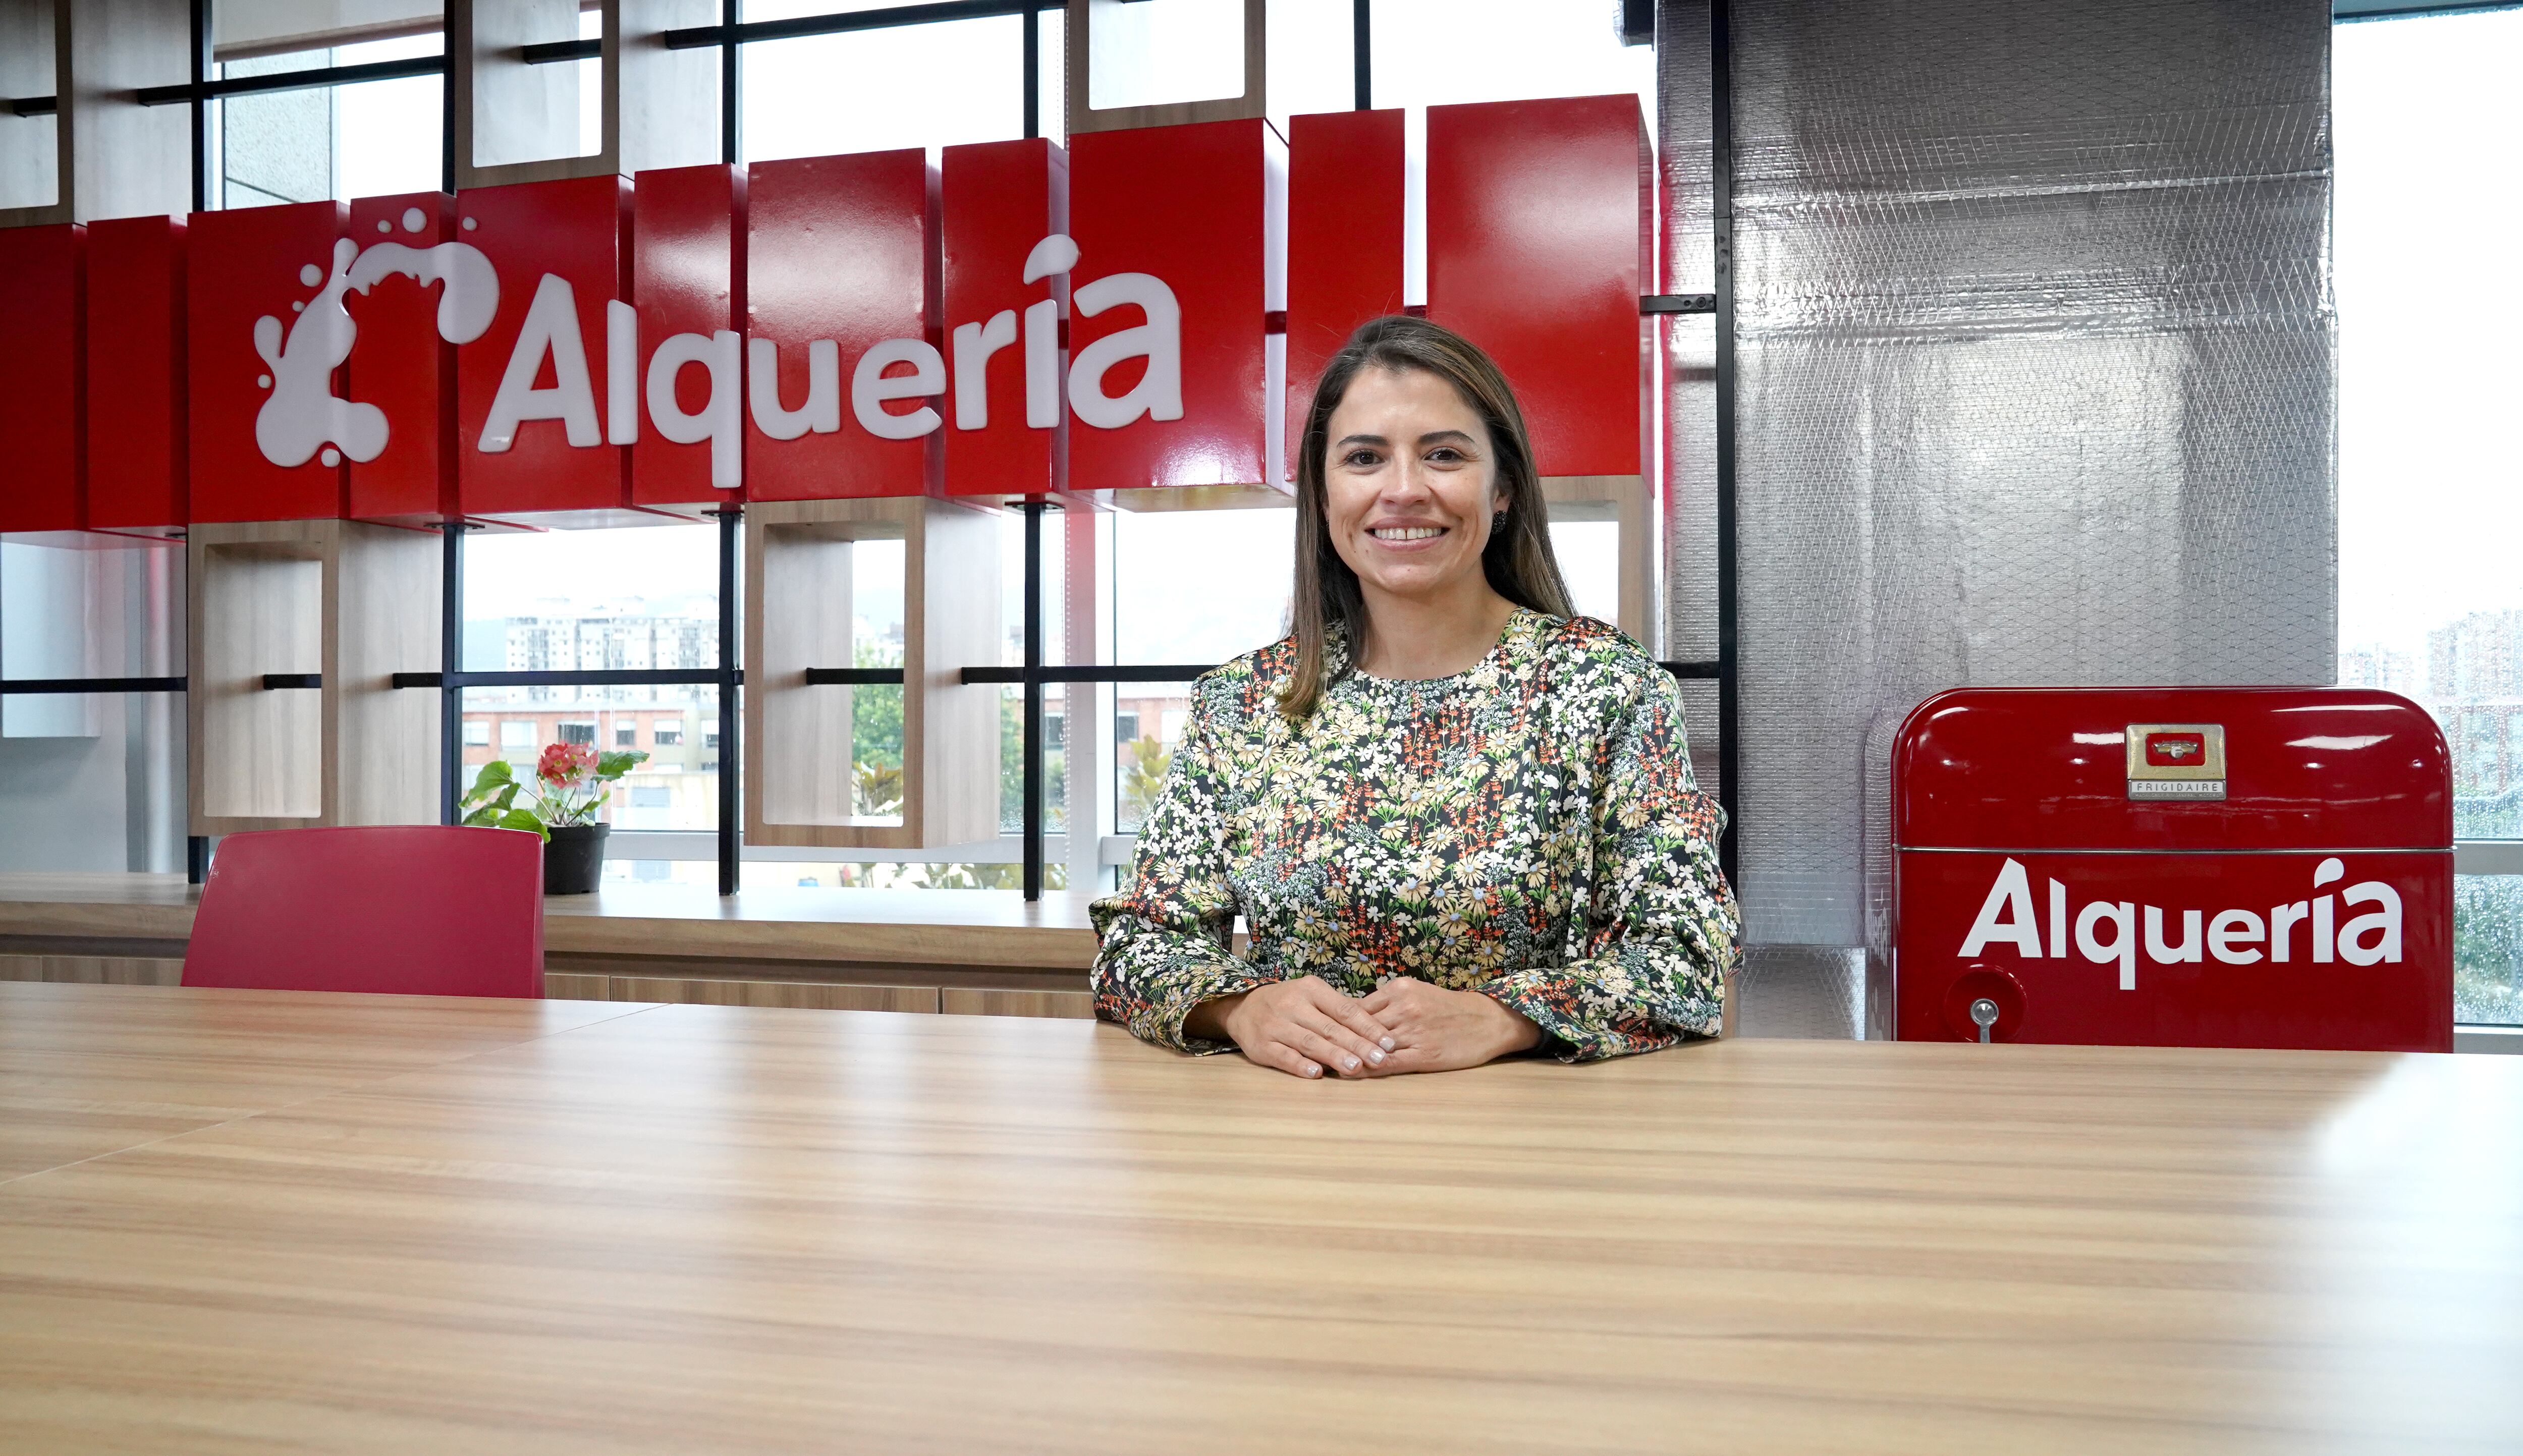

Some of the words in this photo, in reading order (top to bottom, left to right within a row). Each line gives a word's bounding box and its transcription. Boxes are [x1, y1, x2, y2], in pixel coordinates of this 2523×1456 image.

[477, 233, 1185, 488] Alquería
[2137, 783, 2218, 791] FRIGIDAIRE
[1957, 857, 2402, 990] Alquería
